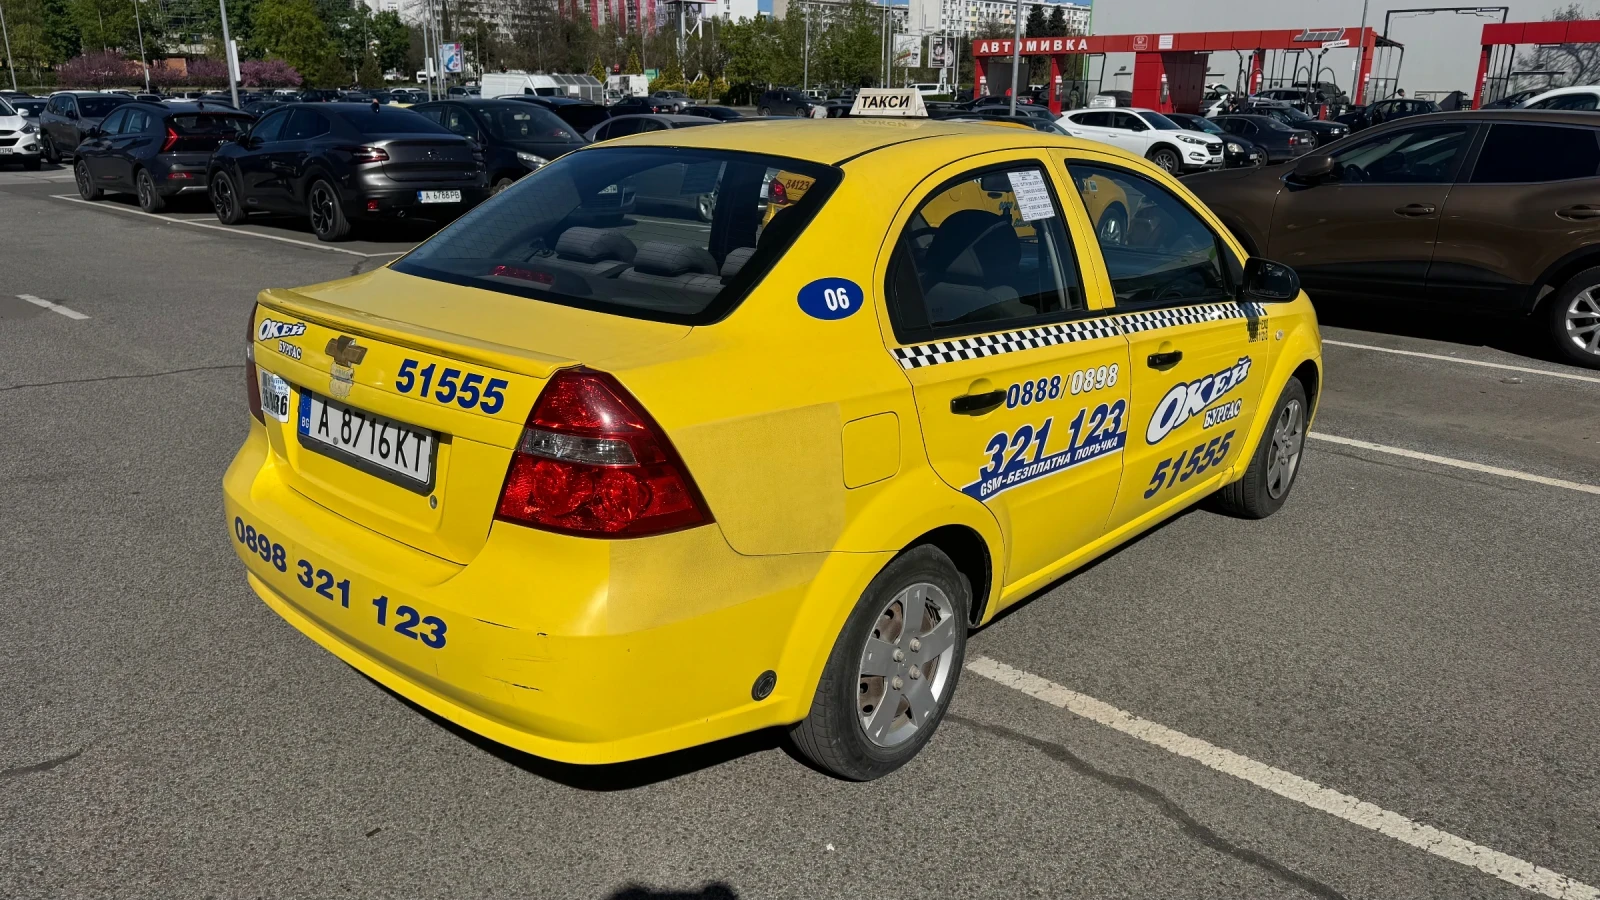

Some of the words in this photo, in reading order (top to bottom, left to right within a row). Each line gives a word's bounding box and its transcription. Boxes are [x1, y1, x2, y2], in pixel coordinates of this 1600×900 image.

[861, 95, 910, 109] ТАКСИ
[425, 192, 431, 200] A
[785, 178, 811, 191] 84123
[823, 287, 850, 312] 06
[257, 318, 307, 341] ОКЕЙ
[277, 340, 303, 360] БУРГАС
[395, 358, 509, 415] 51555
[1146, 355, 1252, 445] ОКЕЙ
[301, 416, 310, 429] BG
[318, 400, 329, 438] A
[1203, 398, 1243, 429] БУРГАС
[979, 416, 1054, 475] 321
[1067, 399, 1127, 452] 123
[980, 452, 1071, 497] GSM-БЕЗПЛАТНА
[1074, 436, 1119, 461] ПОРЪЧКА
[1144, 429, 1236, 499] 51555
[234, 516, 287, 573] 0898
[297, 559, 350, 609] 321
[372, 595, 447, 649] 123
